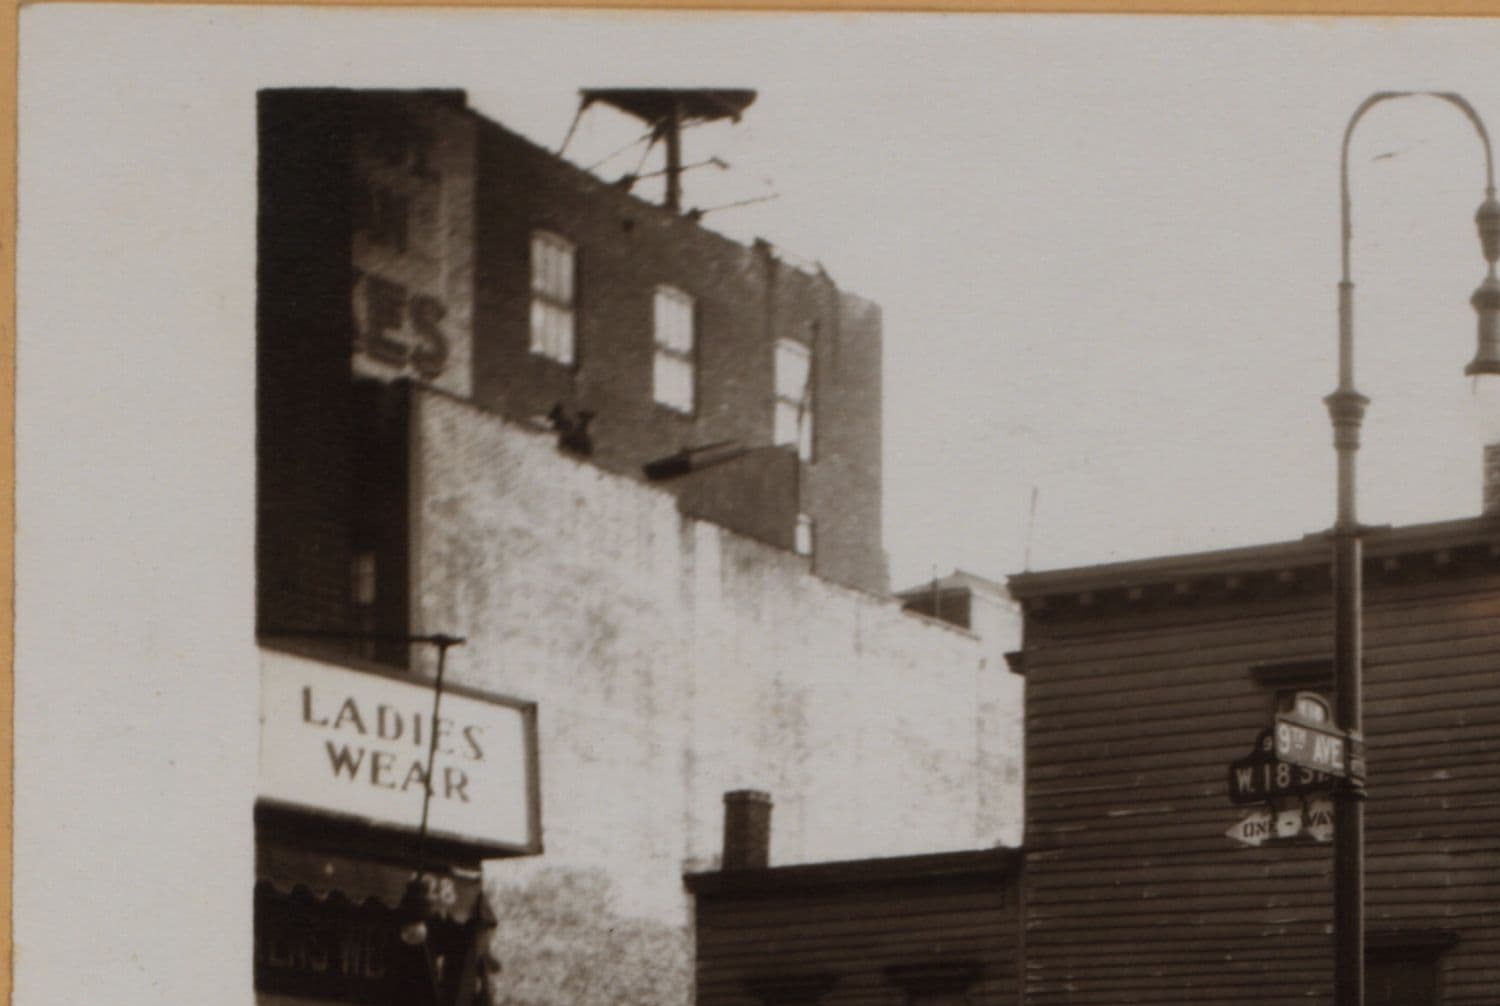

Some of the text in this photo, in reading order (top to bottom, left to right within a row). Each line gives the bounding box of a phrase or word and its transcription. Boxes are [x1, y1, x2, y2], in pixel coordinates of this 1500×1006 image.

[302, 685, 485, 761] LADIES
[325, 740, 470, 802] WEAR
[1264, 762, 1291, 791] 18
[1312, 737, 1344, 770] AVE
